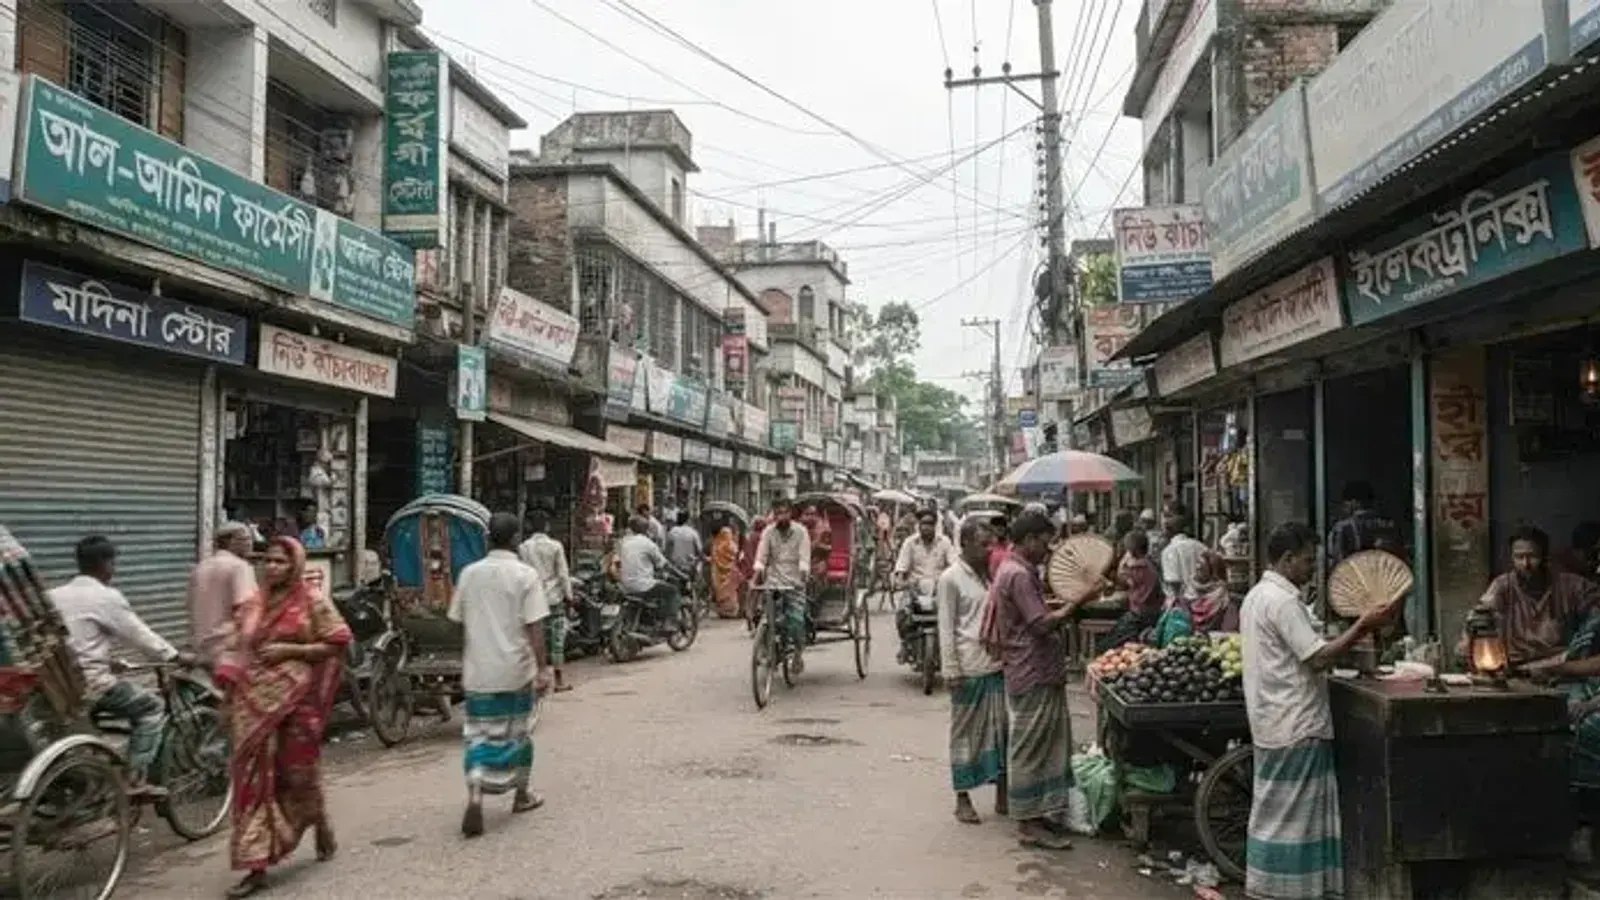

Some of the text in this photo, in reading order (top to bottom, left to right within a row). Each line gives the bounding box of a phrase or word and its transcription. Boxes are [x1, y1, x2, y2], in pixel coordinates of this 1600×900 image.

[37, 107, 226, 230] আল-আমিন
[1350, 178, 1555, 305] ইলেকট্রনিক্স
[47, 279, 235, 356] মদিনা স্টোর
[272, 331, 308, 372] নিউ
